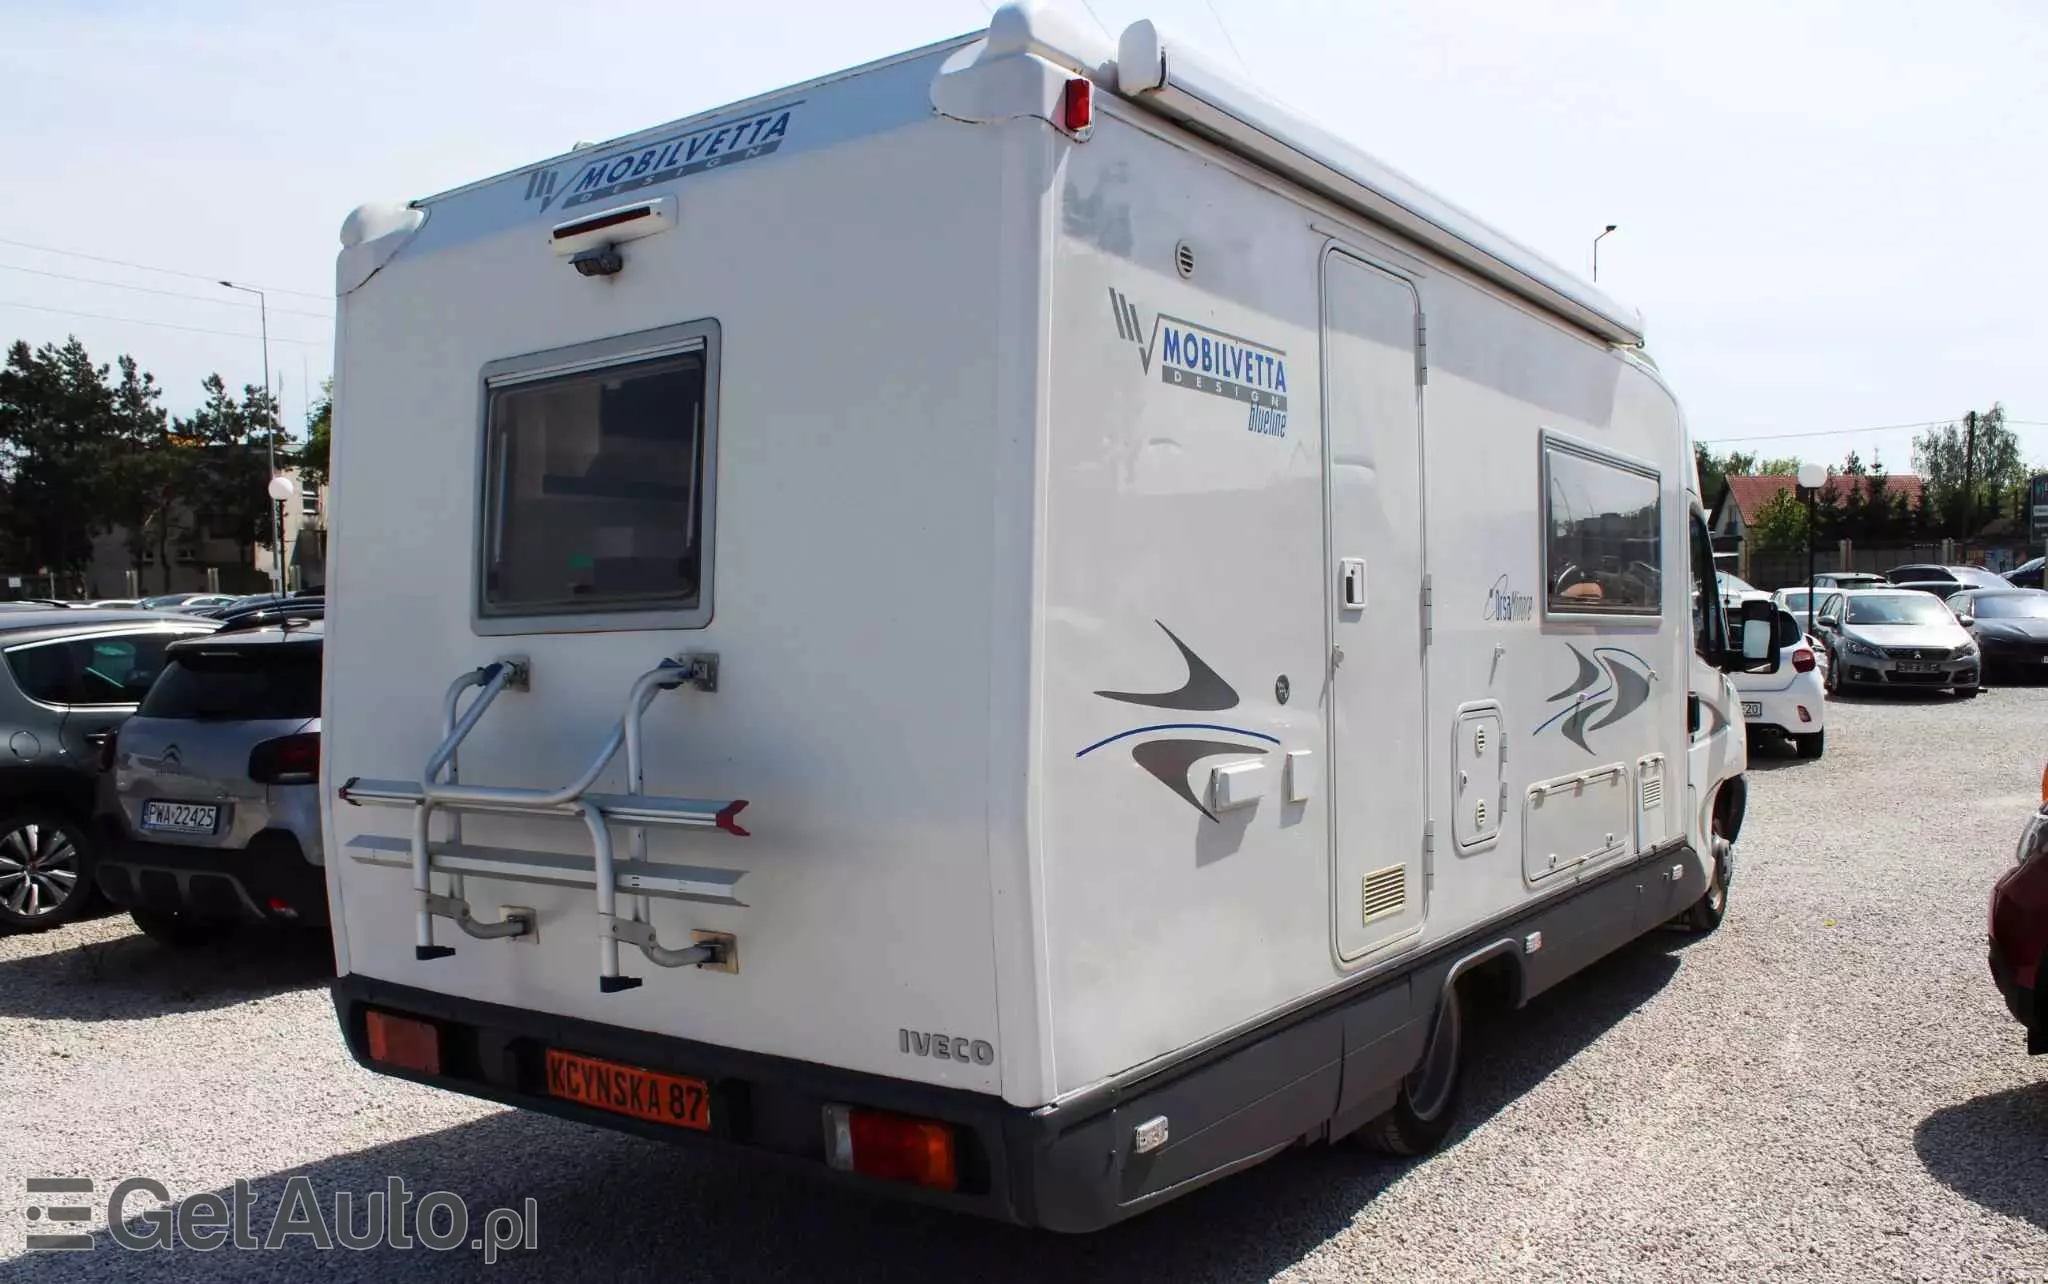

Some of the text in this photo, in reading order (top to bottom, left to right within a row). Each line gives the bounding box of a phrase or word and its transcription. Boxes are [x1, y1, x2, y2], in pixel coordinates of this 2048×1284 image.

[574, 112, 792, 193] MOBILVETTA
[578, 147, 762, 202] DESIGN
[1162, 327, 1287, 393] MOBILVETTA
[1173, 371, 1280, 409] DESIGN
[1248, 402, 1287, 438] blueline
[899, 1028, 994, 1066] IVECO
[550, 1057, 702, 1121] KCYNSKA 87
